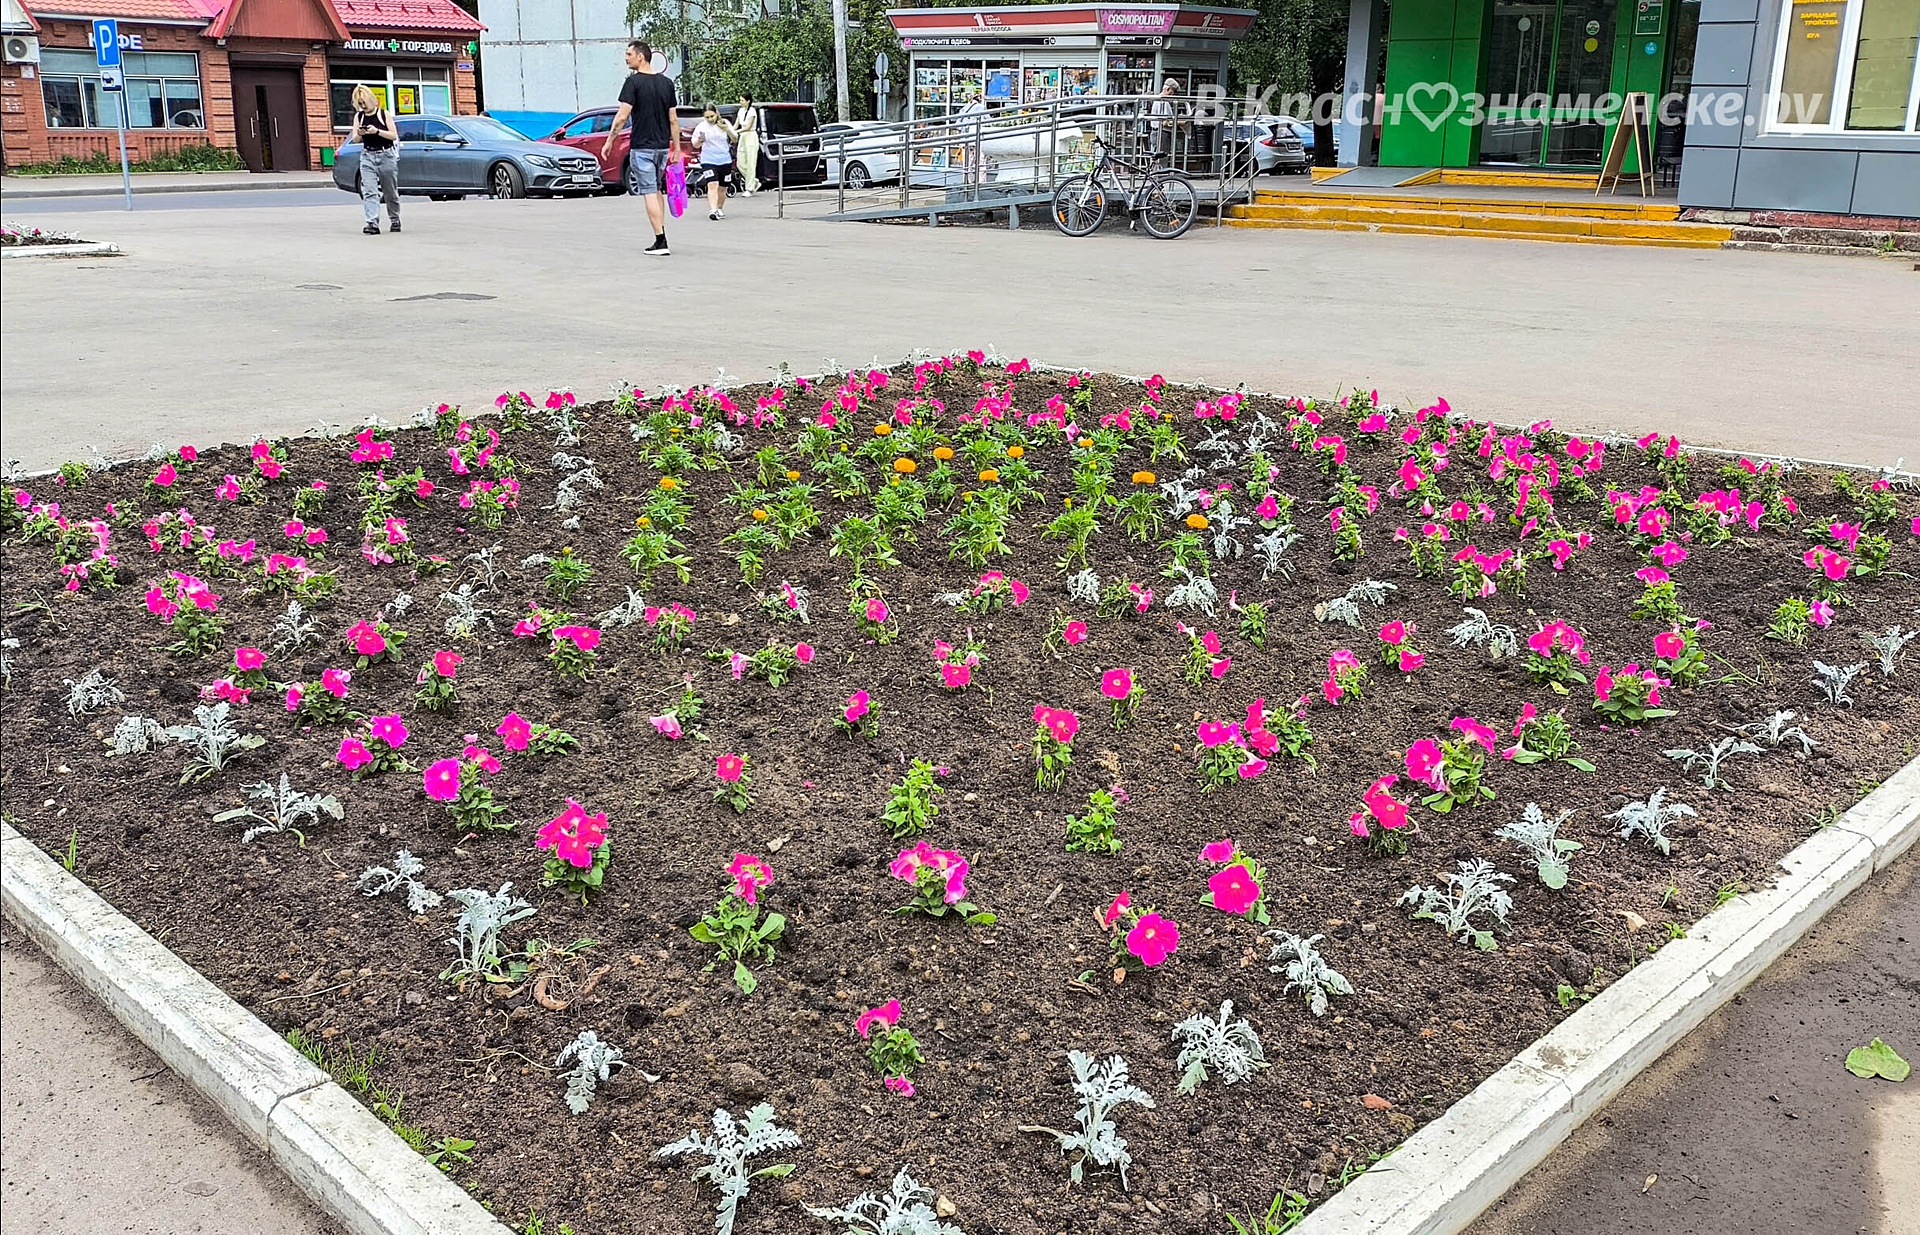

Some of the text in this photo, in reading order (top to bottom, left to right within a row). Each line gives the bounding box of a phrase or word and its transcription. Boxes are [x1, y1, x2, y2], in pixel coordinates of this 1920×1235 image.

[1108, 14, 1165, 26] COSMOPOLITAN
[88, 33, 143, 49] КФЕ
[99, 25, 112, 61] P
[343, 39, 452, 53] АПТЕКИ ГОРЗДРАВ
